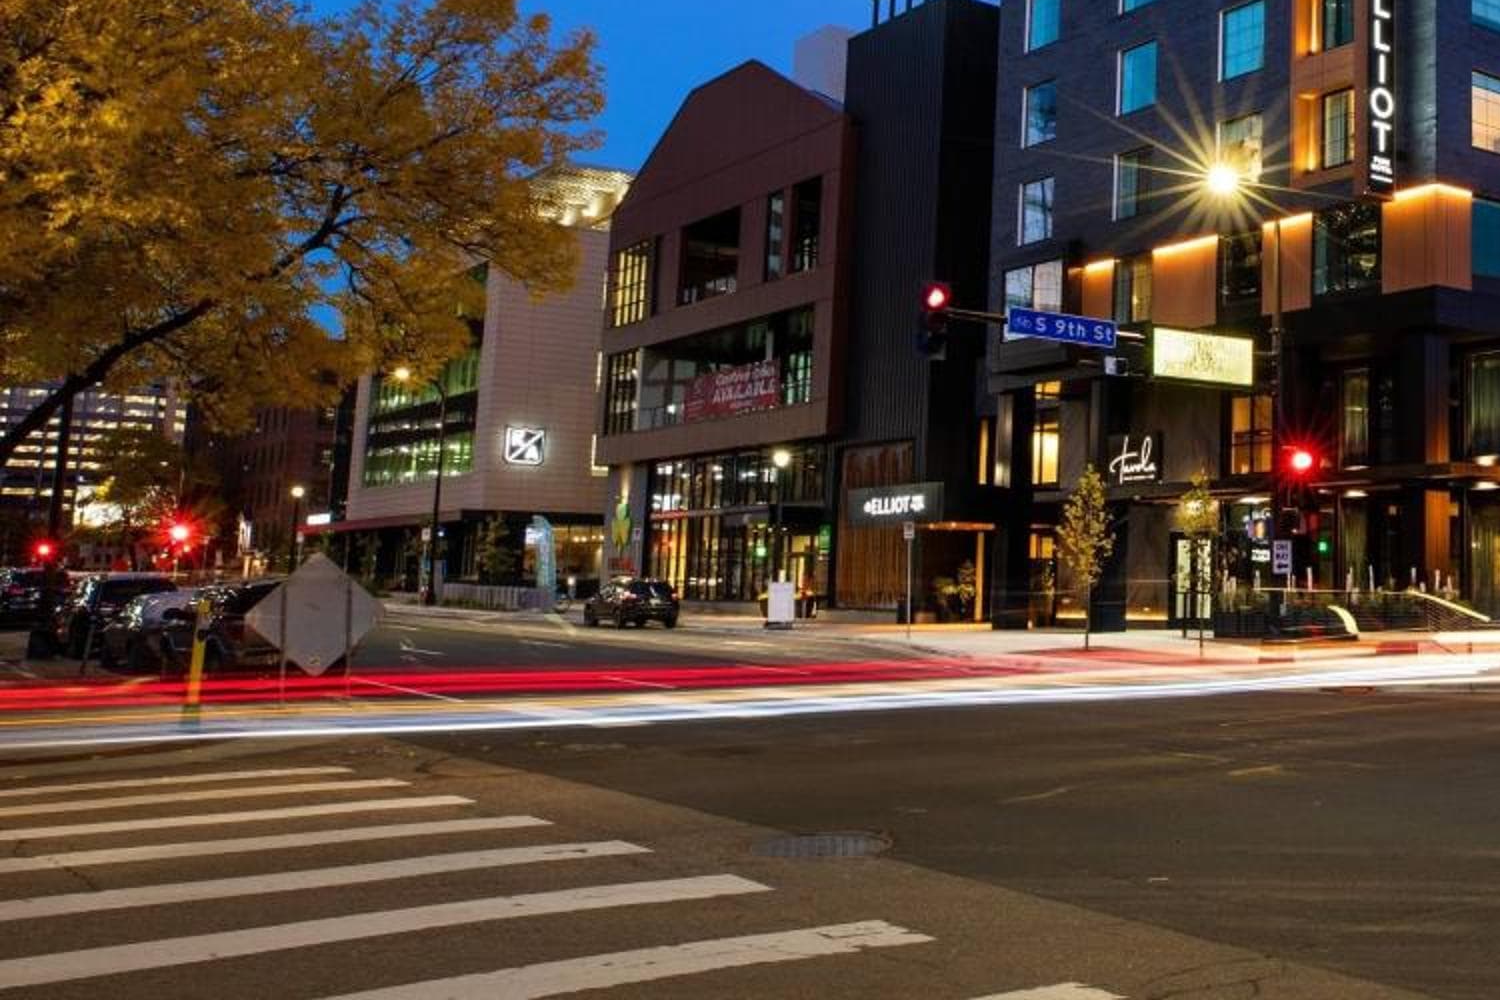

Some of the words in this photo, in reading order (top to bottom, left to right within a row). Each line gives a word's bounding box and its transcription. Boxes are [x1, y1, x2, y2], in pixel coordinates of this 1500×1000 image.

[1035, 317, 1047, 332] S
[1055, 319, 1086, 338] 9th
[1093, 325, 1113, 342] St
[870, 493, 910, 515] ELLIOT
